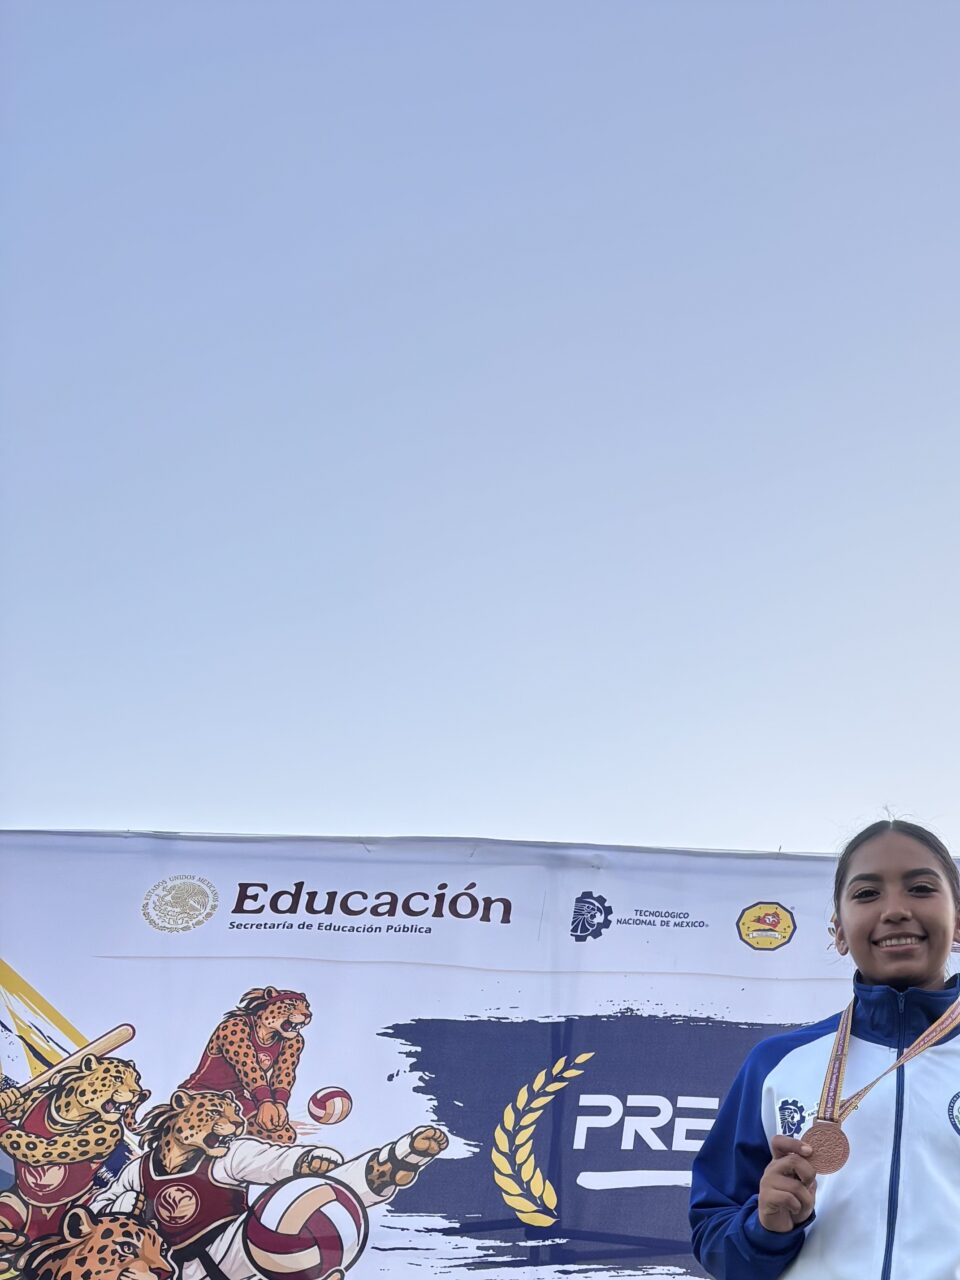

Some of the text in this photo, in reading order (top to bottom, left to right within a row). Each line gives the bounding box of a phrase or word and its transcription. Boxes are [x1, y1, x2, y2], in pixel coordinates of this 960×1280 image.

[230, 881, 512, 925] Educación
[228, 920, 432, 934] Secretaría de Educación Pública
[616, 918, 657, 927] NACIONAL
